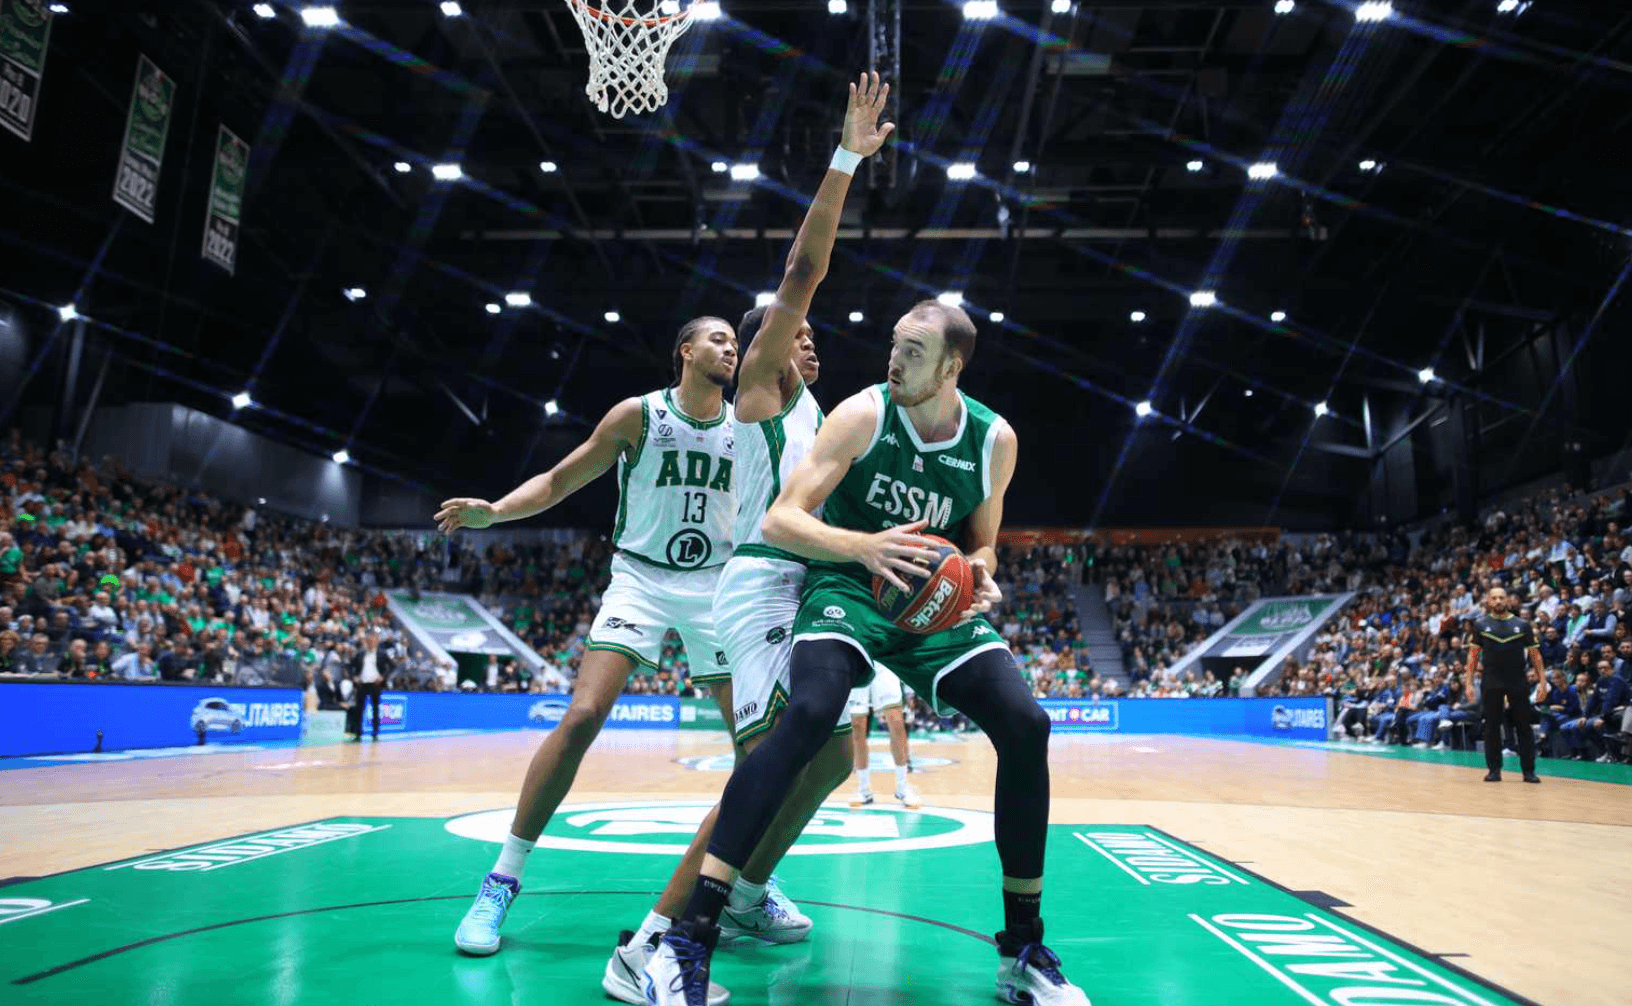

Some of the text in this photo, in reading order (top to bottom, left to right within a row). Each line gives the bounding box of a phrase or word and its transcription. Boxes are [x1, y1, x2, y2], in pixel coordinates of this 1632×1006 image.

[0, 79, 31, 122] 020
[655, 449, 733, 493] ADA
[938, 453, 976, 472] CERMIX
[681, 491, 708, 524] 13
[865, 472, 954, 530] ESSM
[910, 579, 953, 627] Betclic
[611, 704, 675, 721] TAIRES
[1085, 831, 1231, 885] SIDAMO
